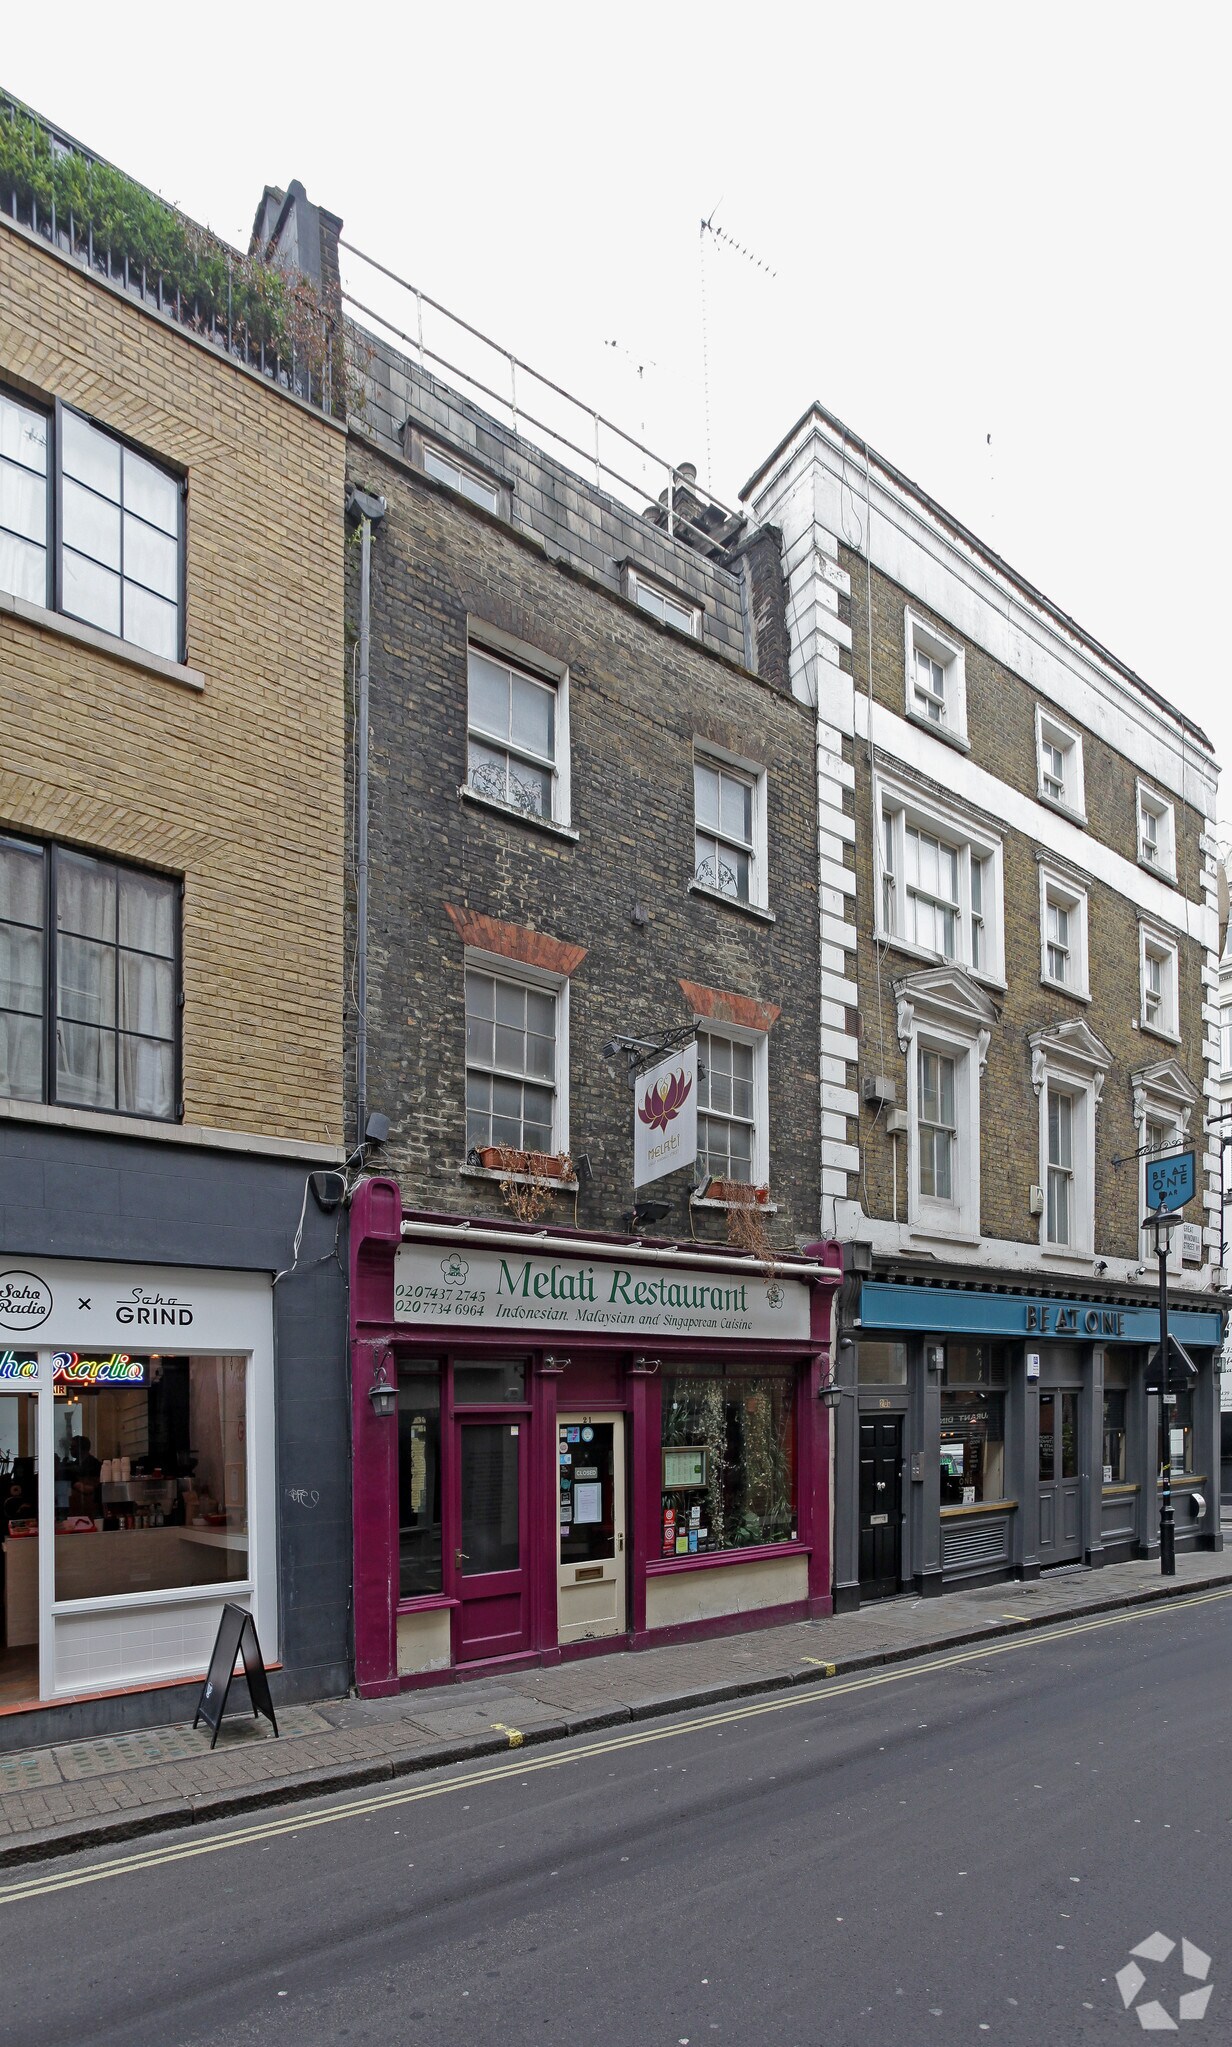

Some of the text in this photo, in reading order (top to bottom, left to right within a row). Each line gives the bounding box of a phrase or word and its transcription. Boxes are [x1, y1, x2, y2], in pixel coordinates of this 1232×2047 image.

[1152, 1164, 1187, 1181] BE AT
[1152, 1173, 1188, 1191] ONE
[0, 1283, 41, 1300] Soho
[496, 1258, 599, 1302] Melati
[607, 1269, 749, 1312] Restaurant
[116, 1288, 192, 1306] Soho
[457, 1289, 486, 1302] 2745
[0, 1300, 47, 1315] Radio
[455, 1303, 485, 1316] 6964
[116, 1307, 193, 1326] GRIND
[575, 1307, 635, 1327] Malaysian
[638, 1312, 662, 1325] and
[662, 1314, 718, 1331] Singaporean
[720, 1317, 753, 1330] Cuisine
[1025, 1304, 1125, 1336] BE AT ONE
[53, 1352, 144, 1381] Radio
[582, 1416, 592, 1424] 21
[576, 1469, 597, 1477] CLOSED
